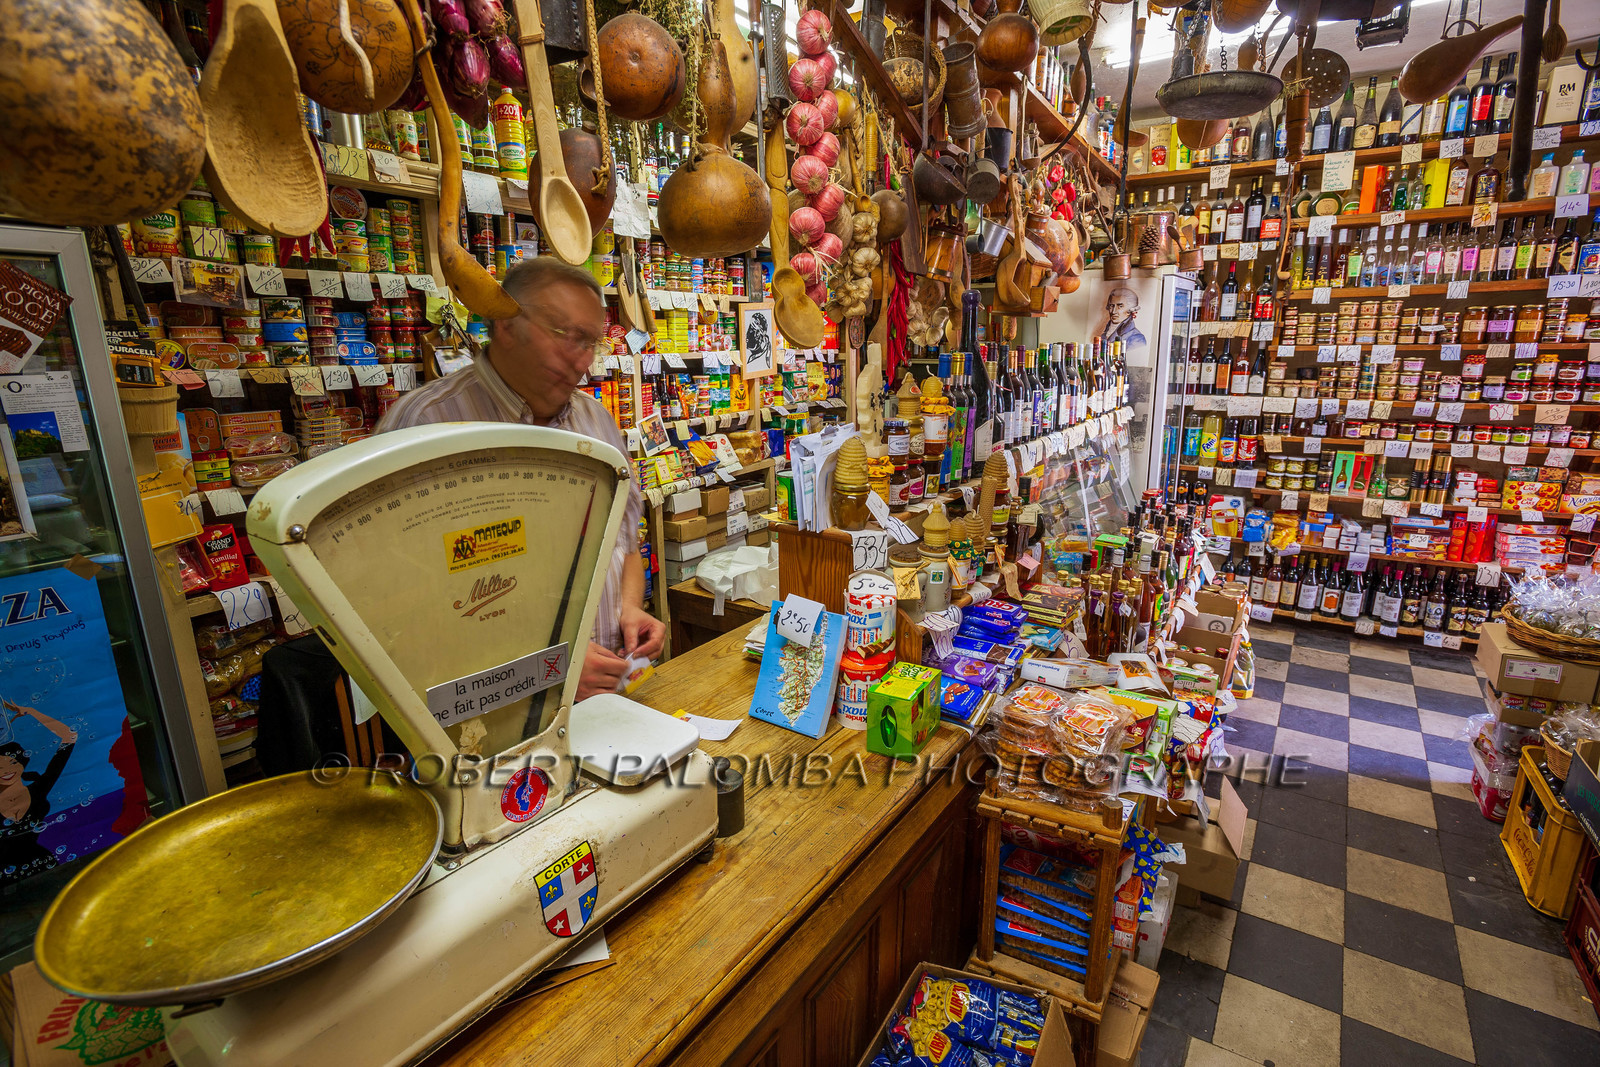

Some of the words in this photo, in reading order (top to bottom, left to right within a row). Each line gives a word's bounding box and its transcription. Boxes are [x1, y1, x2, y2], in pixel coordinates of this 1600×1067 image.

[19, 282, 61, 310] PIGNA
[105, 330, 139, 338] RACELL
[108, 345, 155, 356] DURACELL
[456, 456, 497, 467] GRAMMES
[387, 500, 401, 511] 800
[416, 488, 429, 499] 700
[445, 480, 457, 489] 600
[472, 475, 484, 484] 500
[498, 472, 509, 480] 400
[522, 472, 534, 480] 300
[546, 474, 557, 482] 200
[569, 478, 578, 486] 100
[474, 519, 521, 543] MATEQUIP
[210, 553, 238, 564] Familial
[0, 586, 72, 627] ZA
[479, 608, 506, 622] LYON
[455, 682, 467, 696] la
[472, 668, 515, 691] maison
[433, 709, 450, 722] ne
[454, 699, 475, 716] fait
[479, 691, 501, 711] pas
[505, 676, 536, 698] crédit
[545, 849, 584, 880] CORTE
[36, 994, 88, 1045] FRUI
